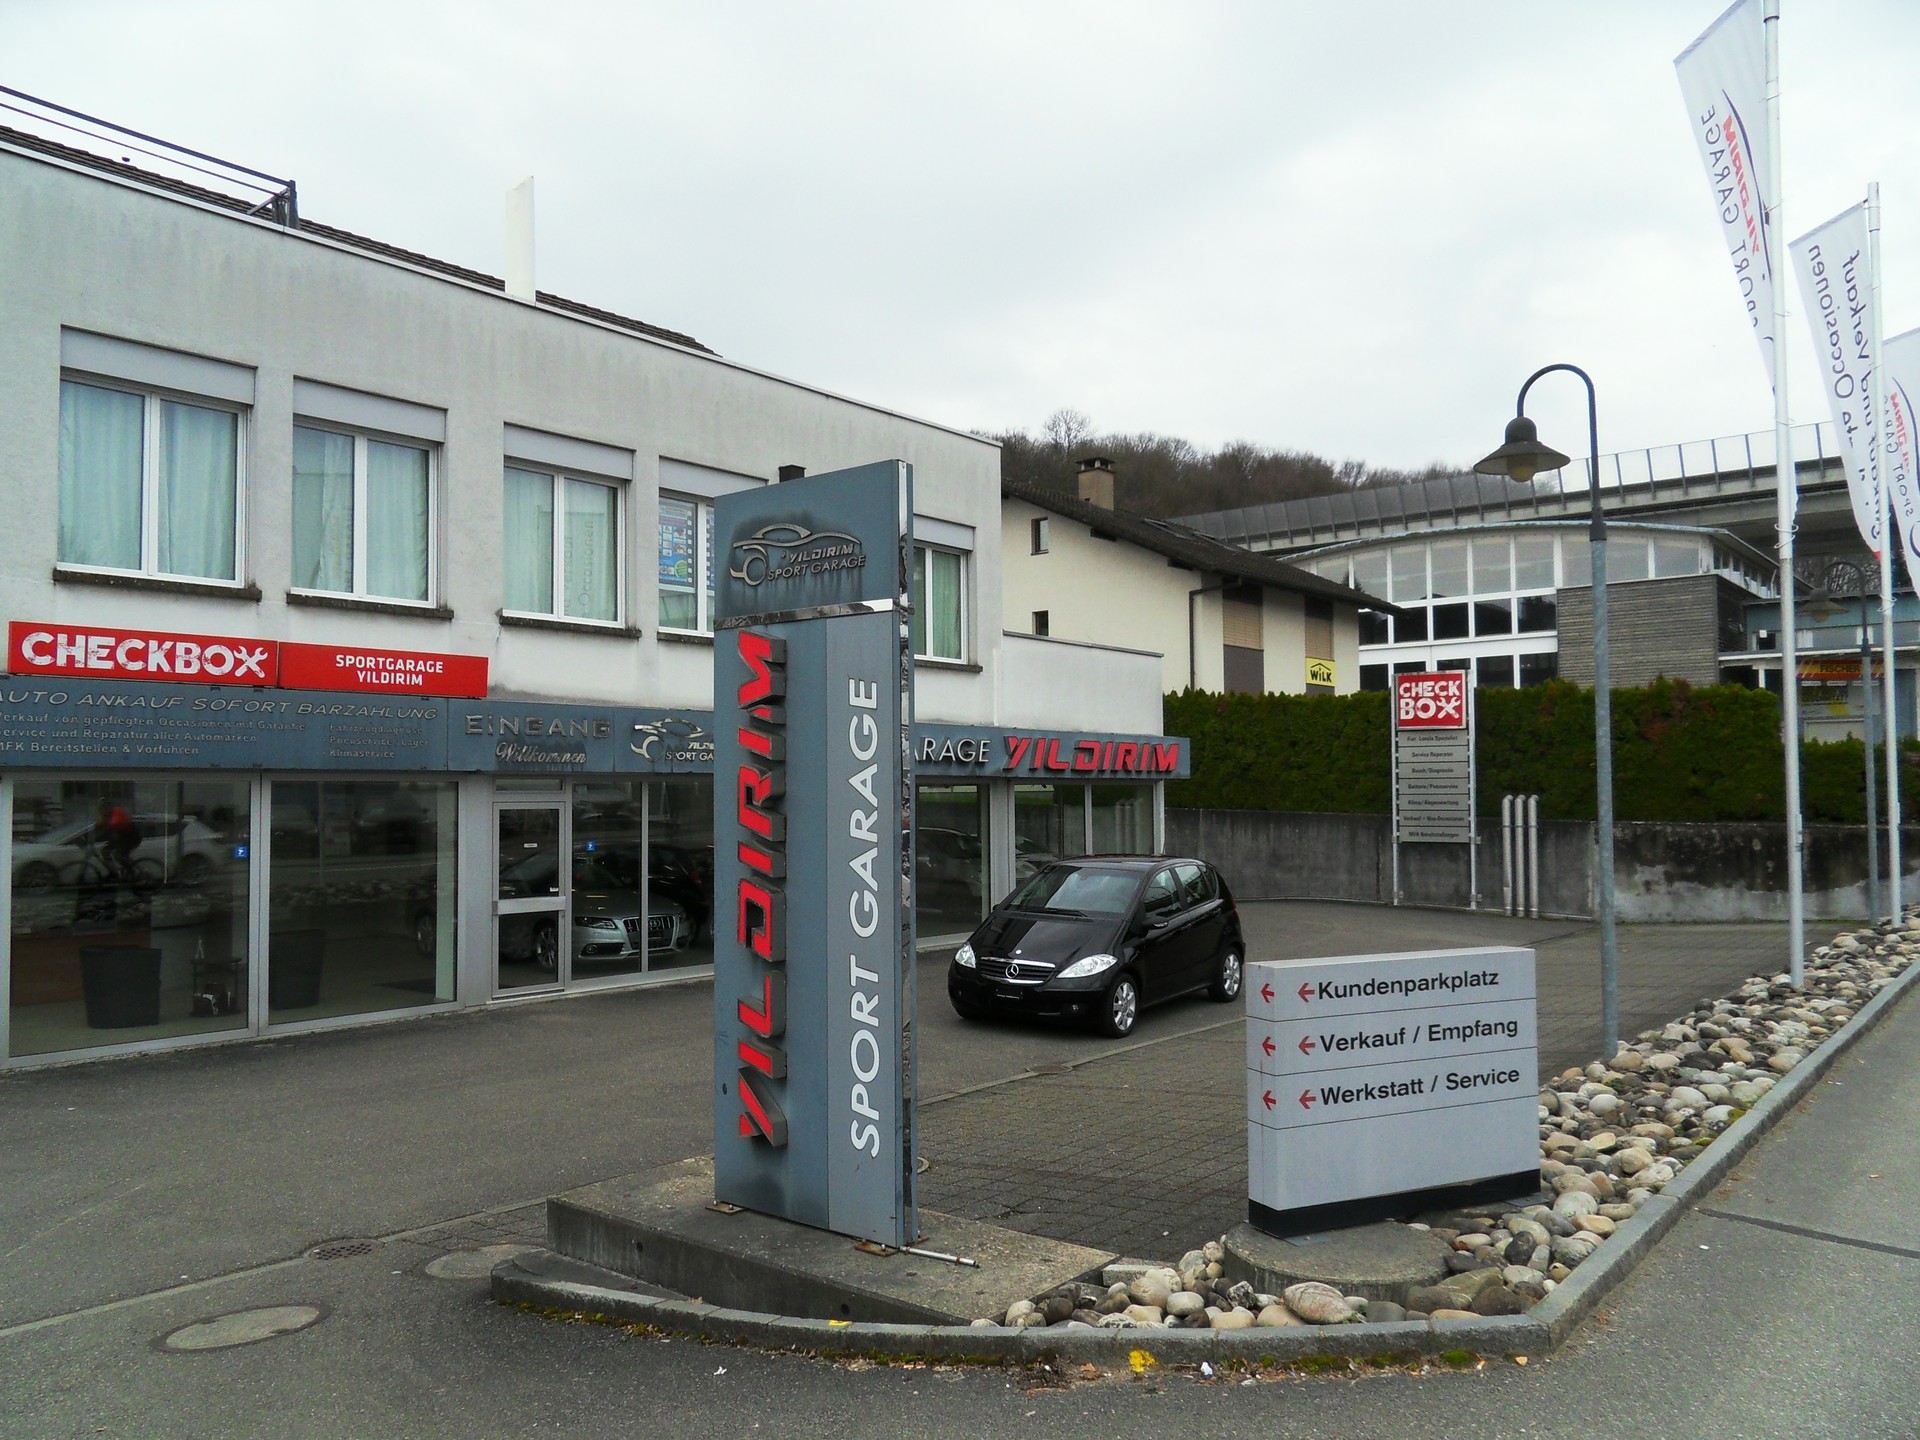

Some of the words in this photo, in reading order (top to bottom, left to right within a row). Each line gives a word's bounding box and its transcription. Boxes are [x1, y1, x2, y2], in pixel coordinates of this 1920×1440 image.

[789, 543, 855, 563] YILDIRIM
[768, 565, 808, 581] SPORT
[811, 555, 867, 574] GARAGE
[20, 631, 268, 679] CHECKBOX
[335, 654, 444, 674] SPORTGARAGE
[357, 670, 424, 687] YILDIRIM
[1399, 680, 1461, 698] CHECK
[77, 694, 185, 708] ANKAUF
[192, 698, 291, 713] SOFORT
[297, 703, 437, 719] BARZAHLUNG
[1400, 697, 1461, 720] BOX
[52, 728, 77, 738] und
[83, 728, 148, 740] Reparatur
[31, 742, 117, 754] Bereitstellen
[122, 743, 131, 754] &
[1003, 735, 1179, 772] YILDIRIM
[848, 677, 878, 938] GARAGE
[737, 630, 787, 1147] YILDIRIM
[1318, 970, 1500, 1000] Kundenparkplatz
[1320, 1027, 1406, 1053] Verkauf
[1412, 1026, 1421, 1043] /
[1428, 1020, 1519, 1043] Empfang
[849, 953, 880, 1159] SPORT
[1320, 1077, 1424, 1106] Werkstatt
[1430, 1075, 1439, 1092] /
[1446, 1068, 1521, 1091] Service
